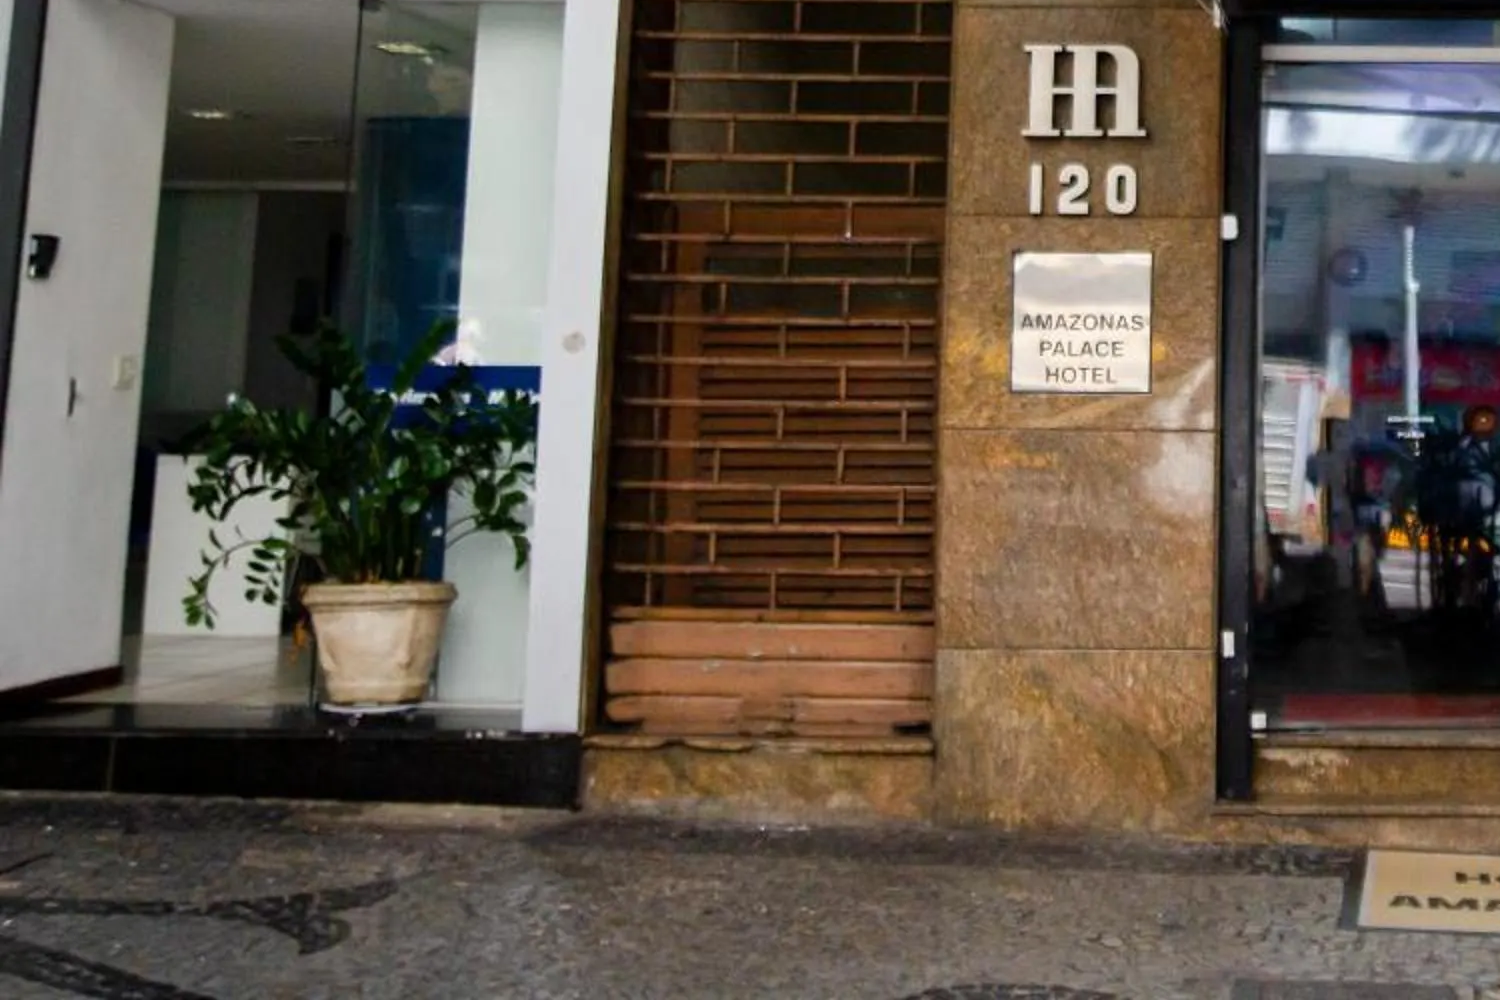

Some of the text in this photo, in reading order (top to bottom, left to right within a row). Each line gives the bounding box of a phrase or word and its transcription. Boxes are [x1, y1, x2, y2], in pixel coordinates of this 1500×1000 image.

[1028, 163, 1138, 216] 120
[1021, 313, 1145, 331] AMAZONAS
[1039, 340, 1124, 358] PALACE
[1045, 367, 1118, 385] HOTEL
